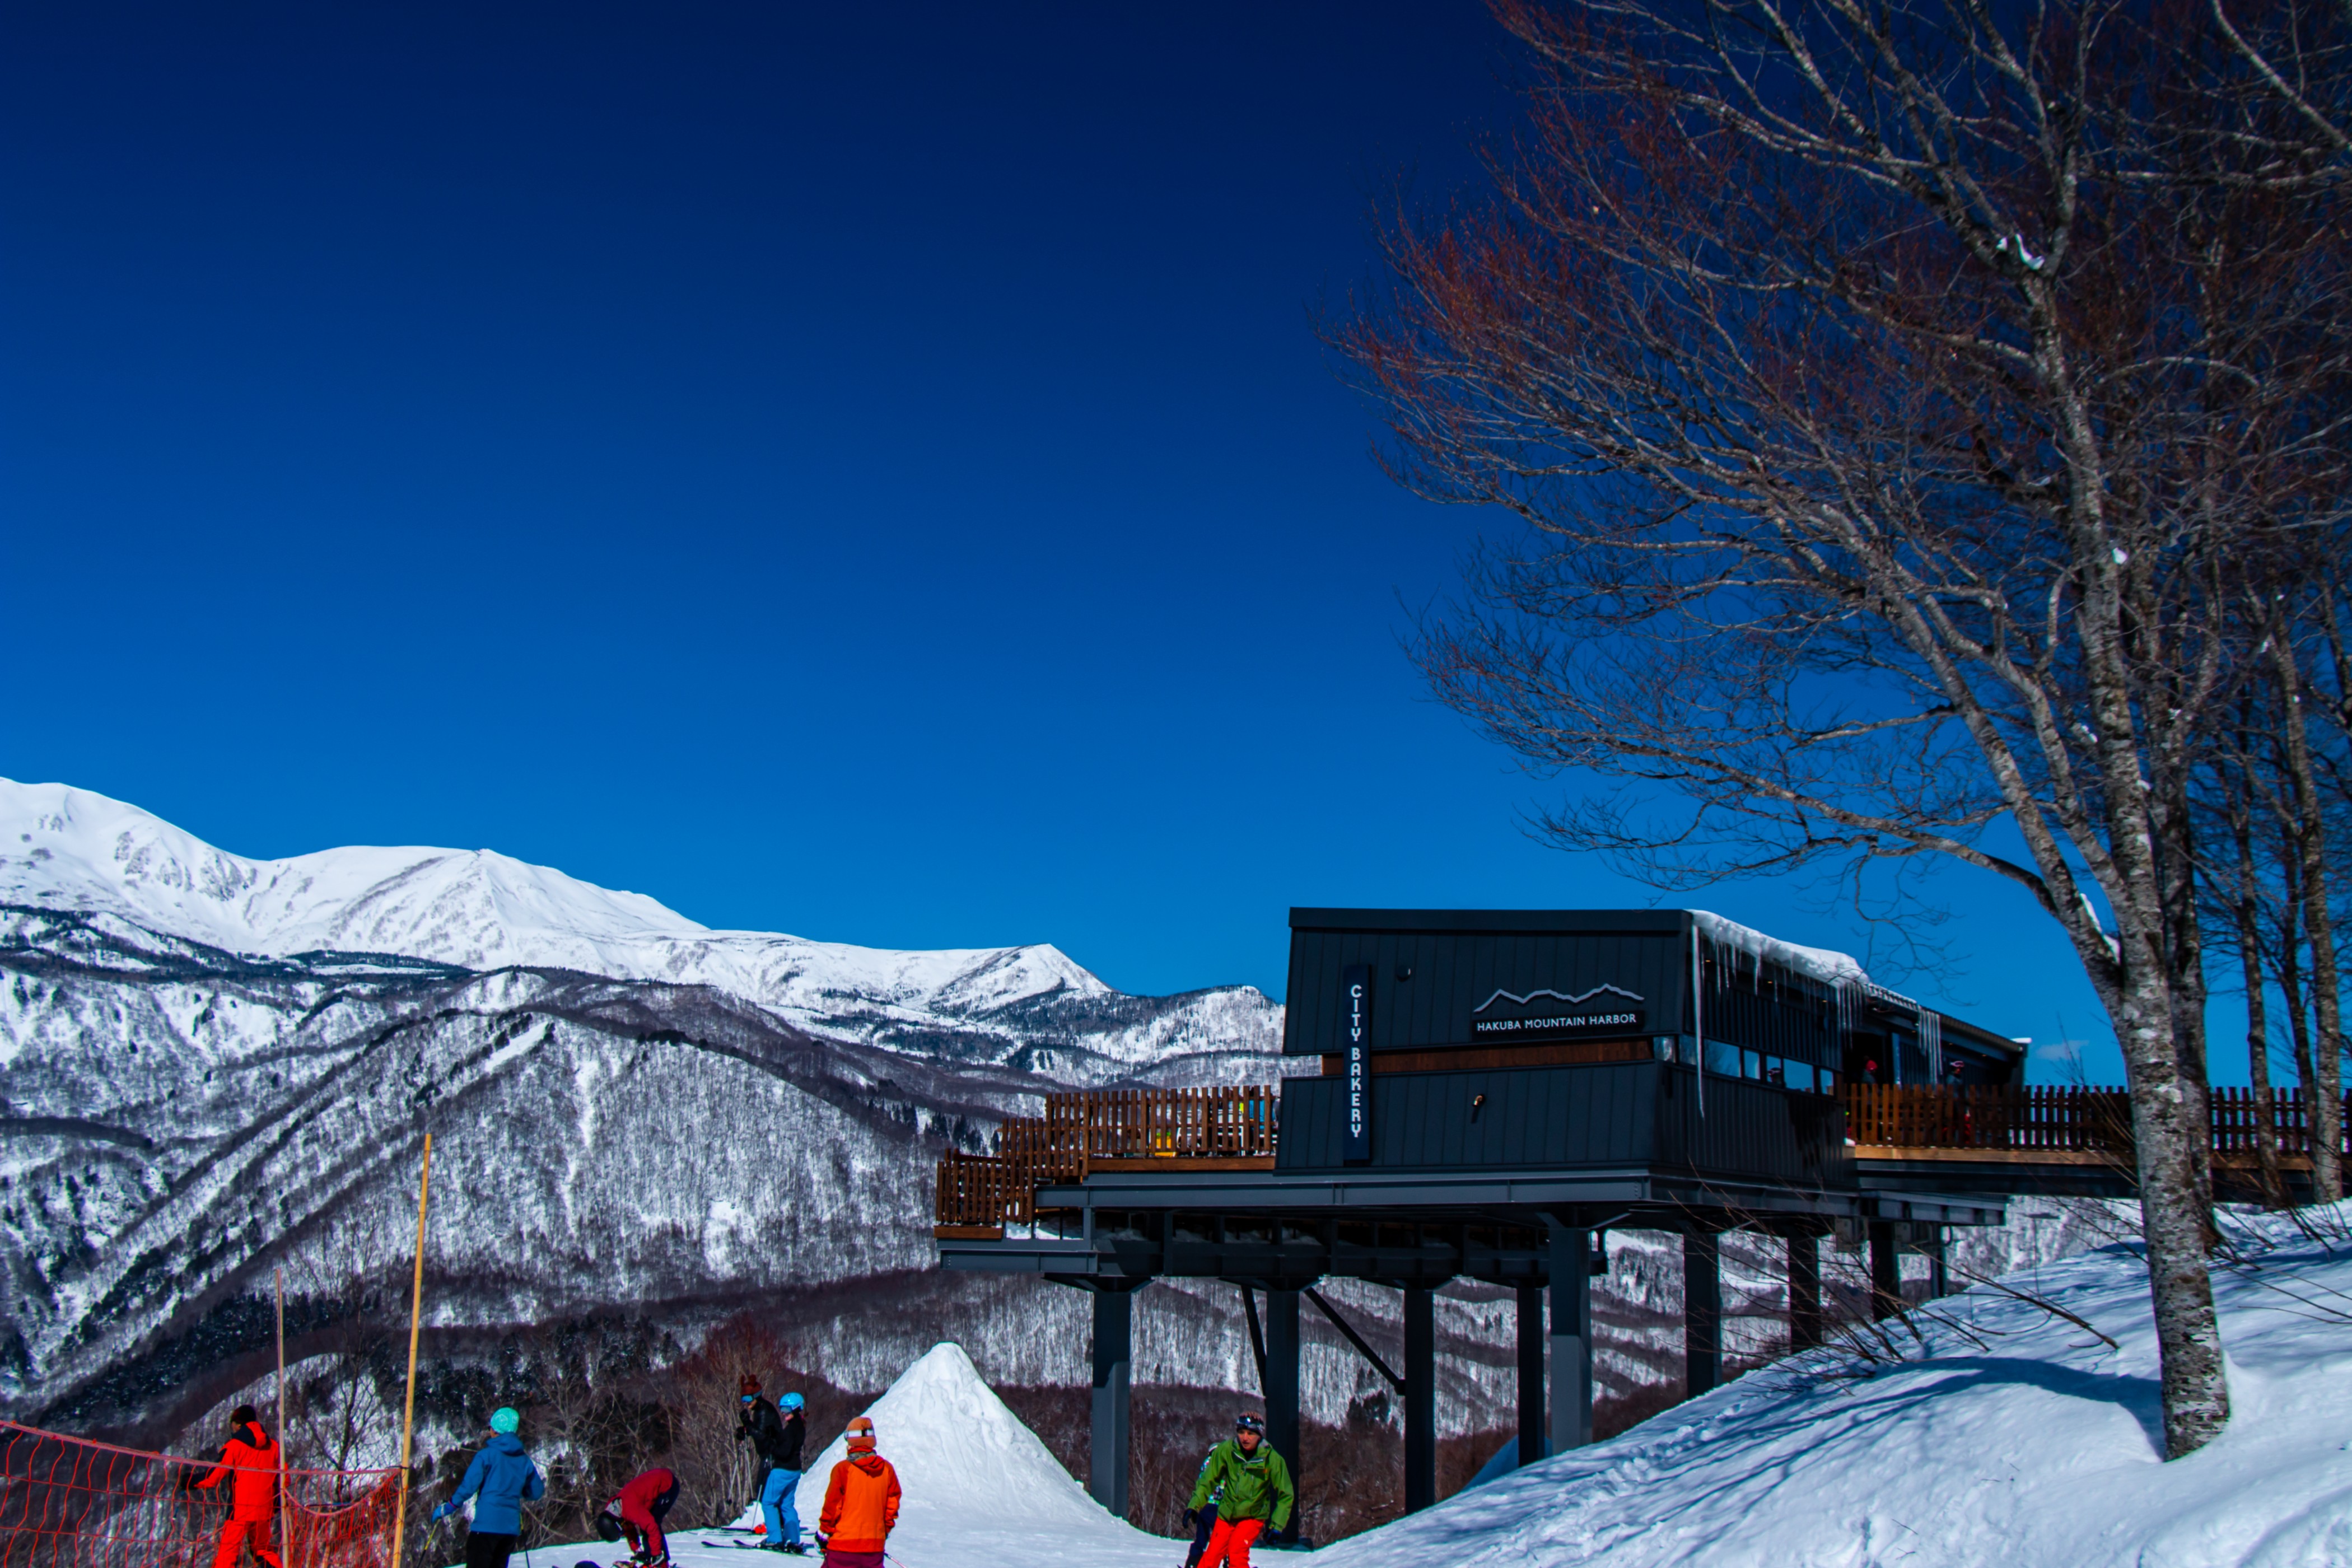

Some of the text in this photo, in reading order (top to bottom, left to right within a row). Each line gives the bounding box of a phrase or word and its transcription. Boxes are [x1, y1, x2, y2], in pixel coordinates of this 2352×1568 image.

[1351, 984, 1362, 1138] CITY BAKERY
[1477, 1013, 1637, 1032] HAKUBA MOUNTAIN HARBOR
